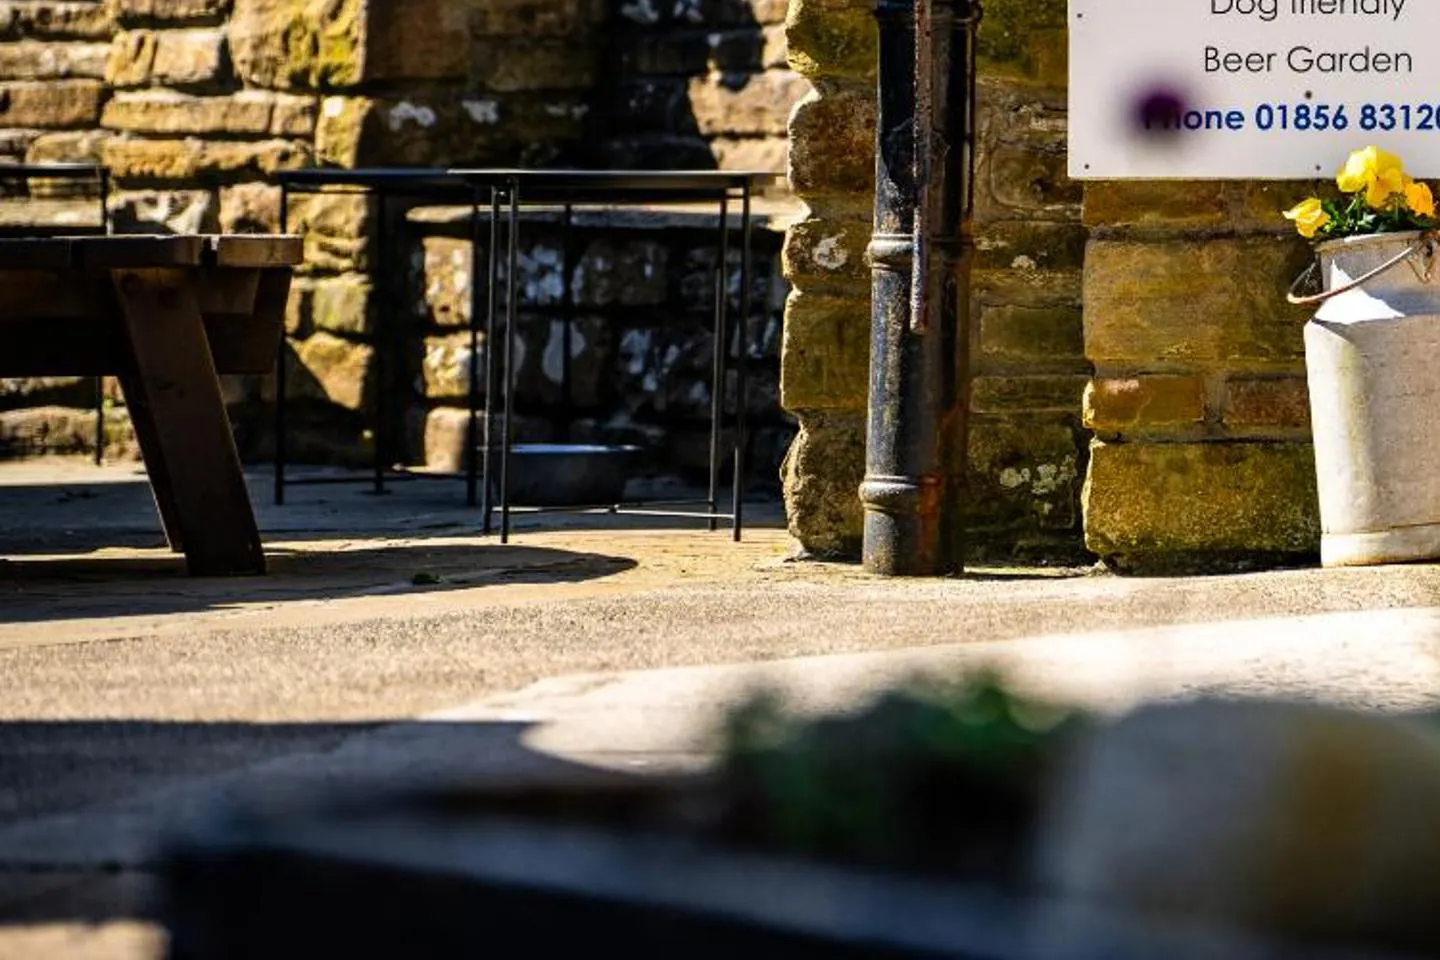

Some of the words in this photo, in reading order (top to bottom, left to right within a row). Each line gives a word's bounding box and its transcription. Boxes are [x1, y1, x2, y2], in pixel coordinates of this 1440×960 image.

[1204, 46, 1277, 73] Beer
[1286, 45, 1413, 74] Garden
[1144, 103, 1245, 132] hone
[1254, 102, 1349, 132] 01856
